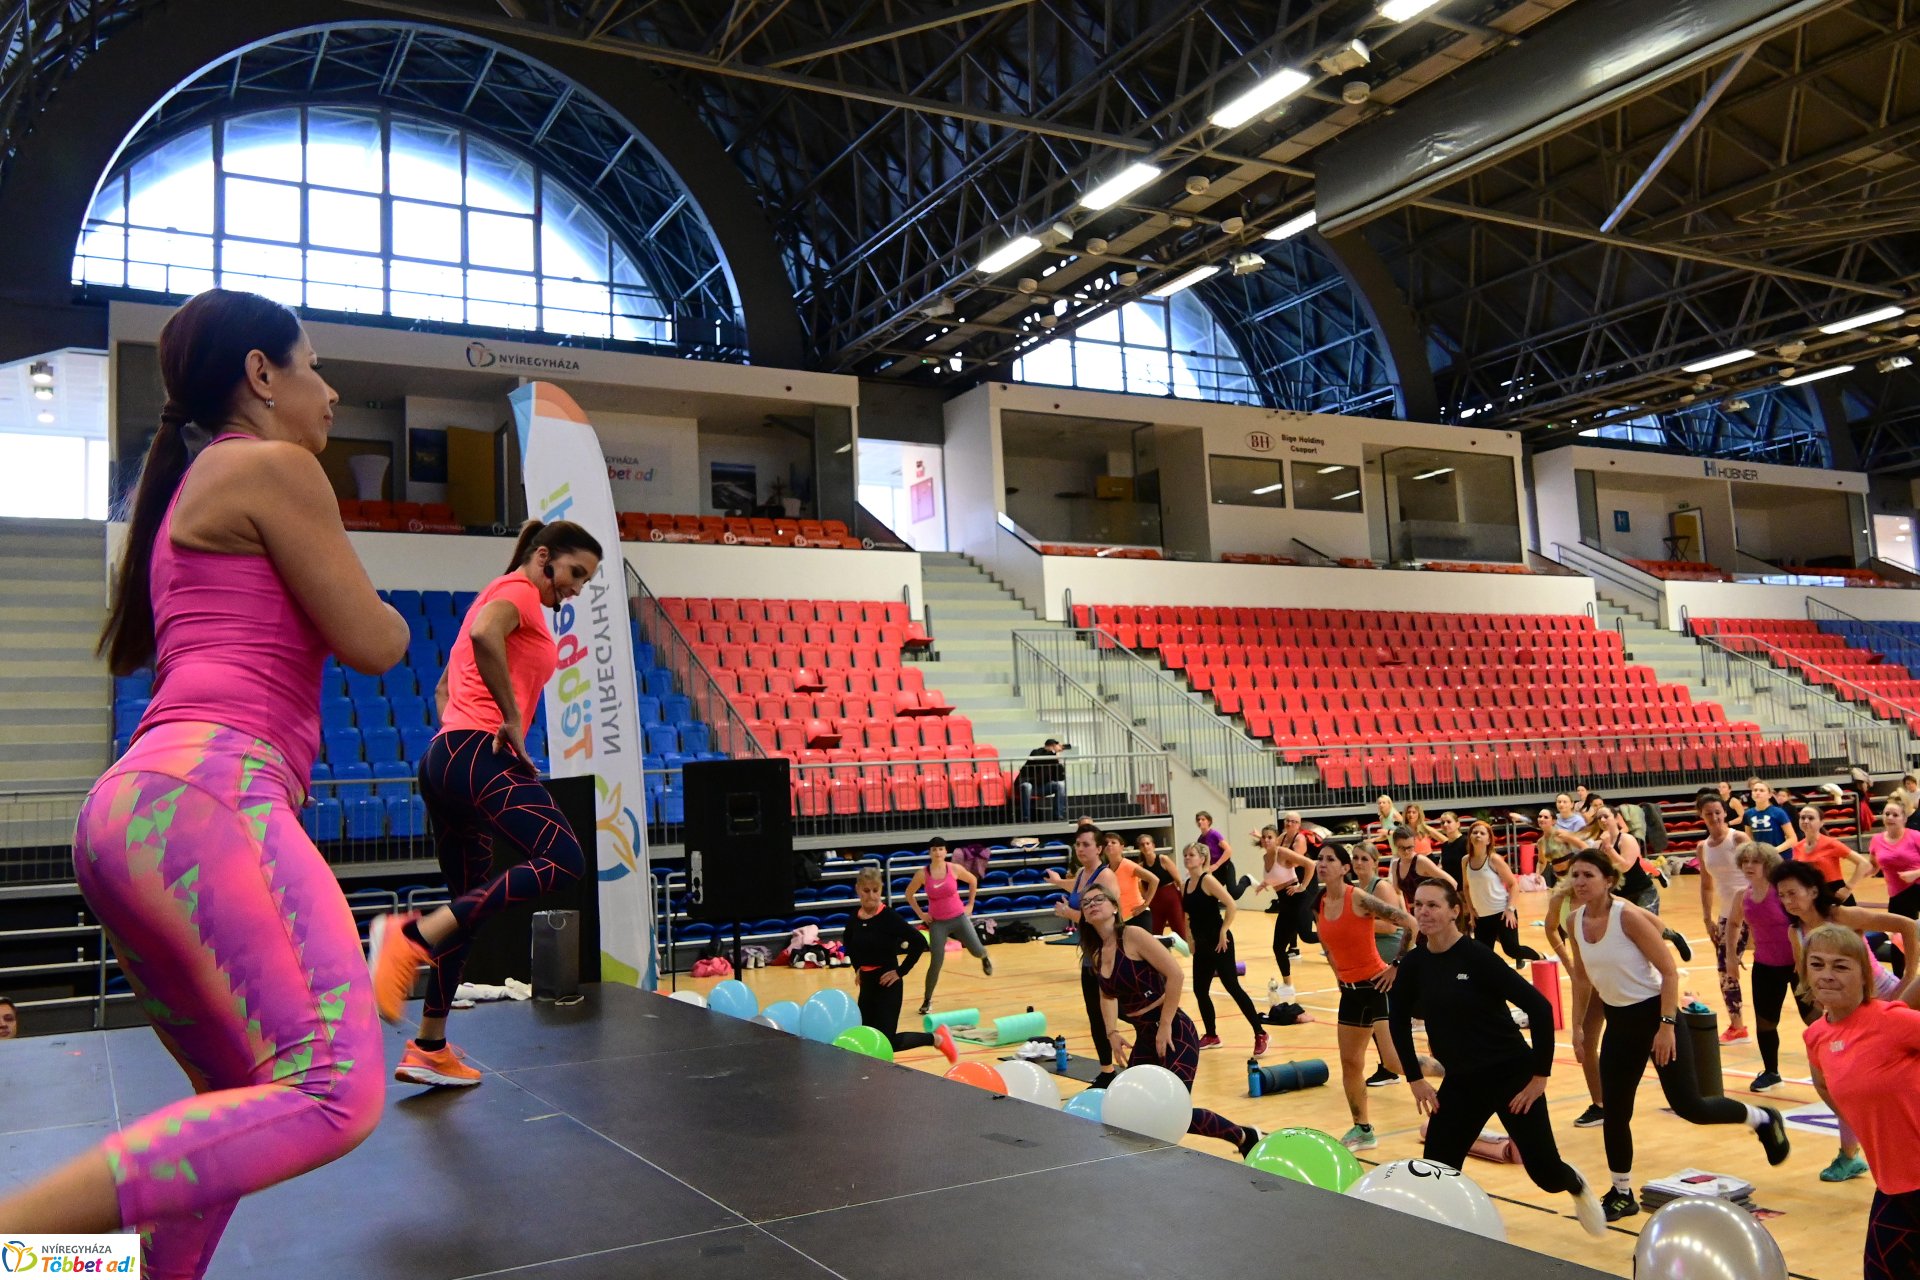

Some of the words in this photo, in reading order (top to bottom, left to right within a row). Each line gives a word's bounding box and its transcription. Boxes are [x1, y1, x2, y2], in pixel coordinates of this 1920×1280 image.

[499, 353, 579, 370] NYÍREGYHÁZA
[1251, 435, 1270, 448] BH
[608, 465, 632, 480] bet
